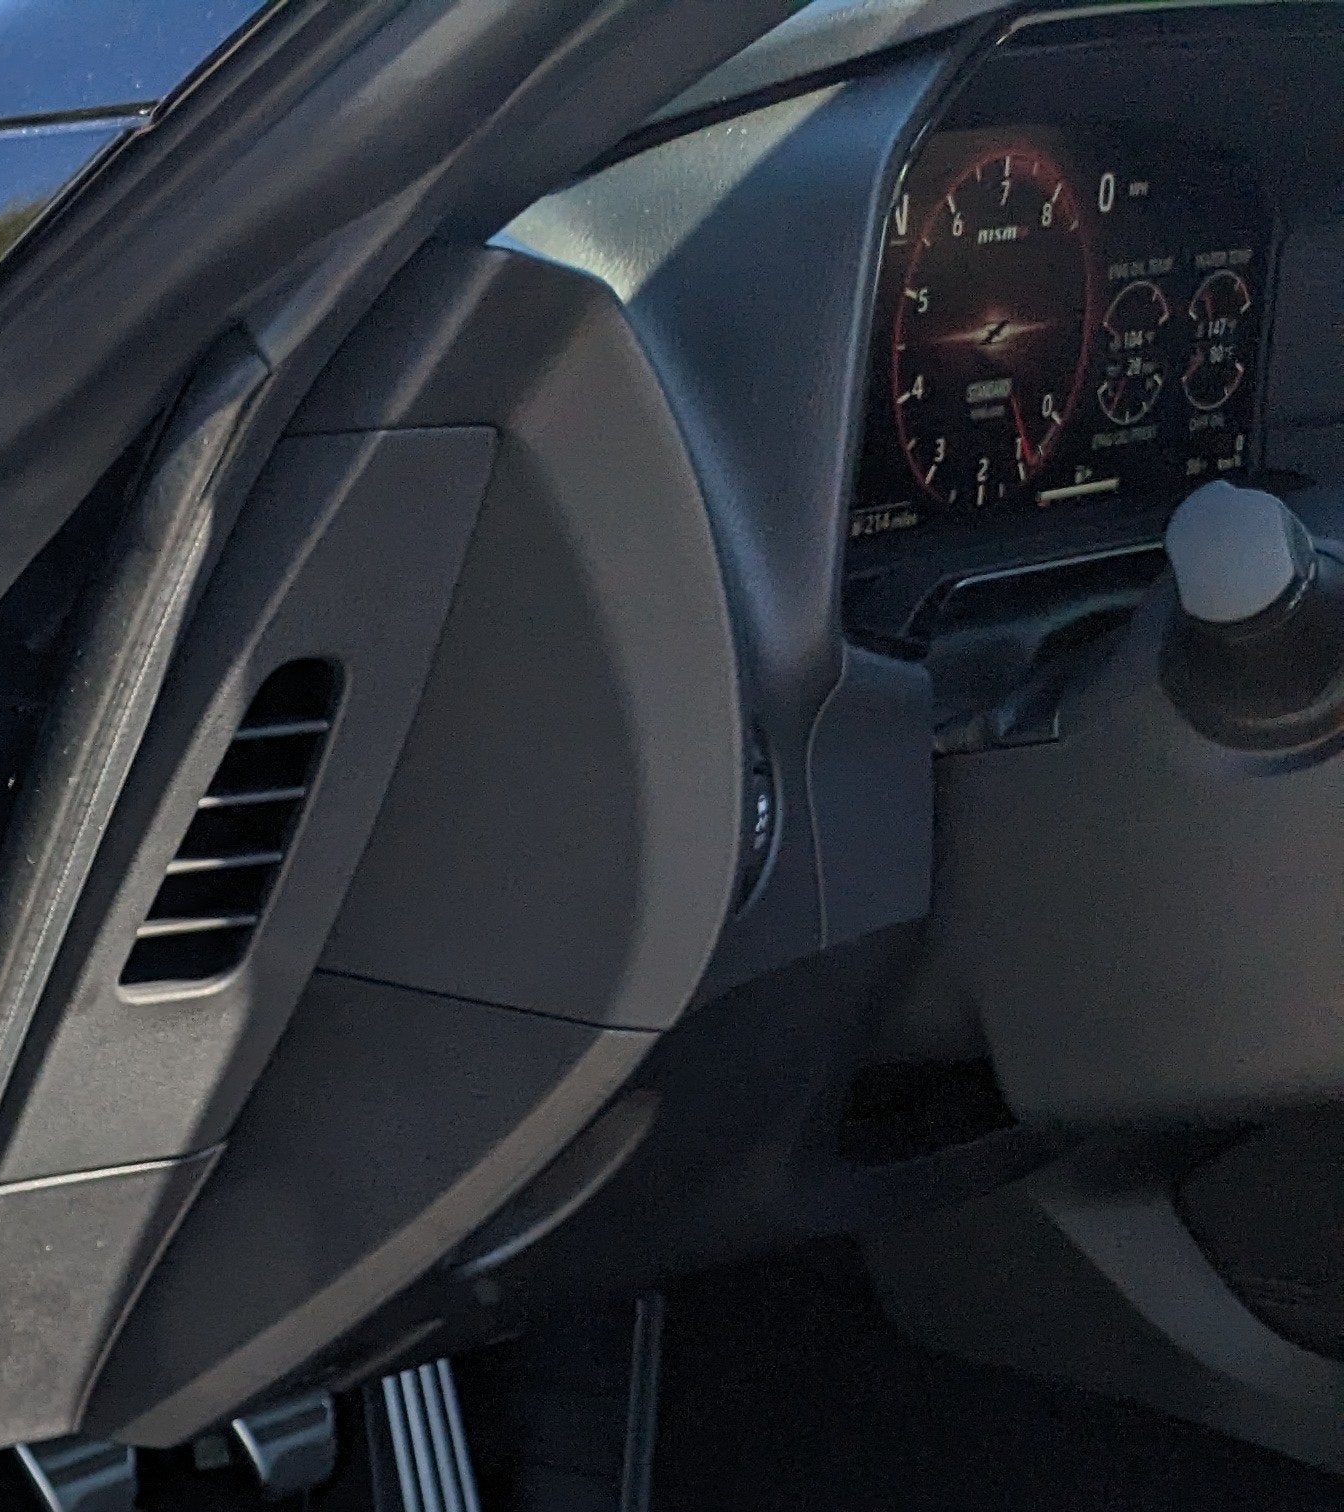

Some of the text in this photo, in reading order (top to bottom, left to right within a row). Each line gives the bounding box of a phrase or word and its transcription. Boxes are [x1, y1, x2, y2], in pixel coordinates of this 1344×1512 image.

[1001, 180, 1011, 205] 7
[953, 212, 963, 236] 6
[1042, 203, 1053, 227] 8
[917, 288, 929, 313] 5
[912, 375, 924, 399] 4
[1042, 394, 1053, 417] 0
[934, 438, 946, 462] 3
[977, 458, 989, 482] 2
